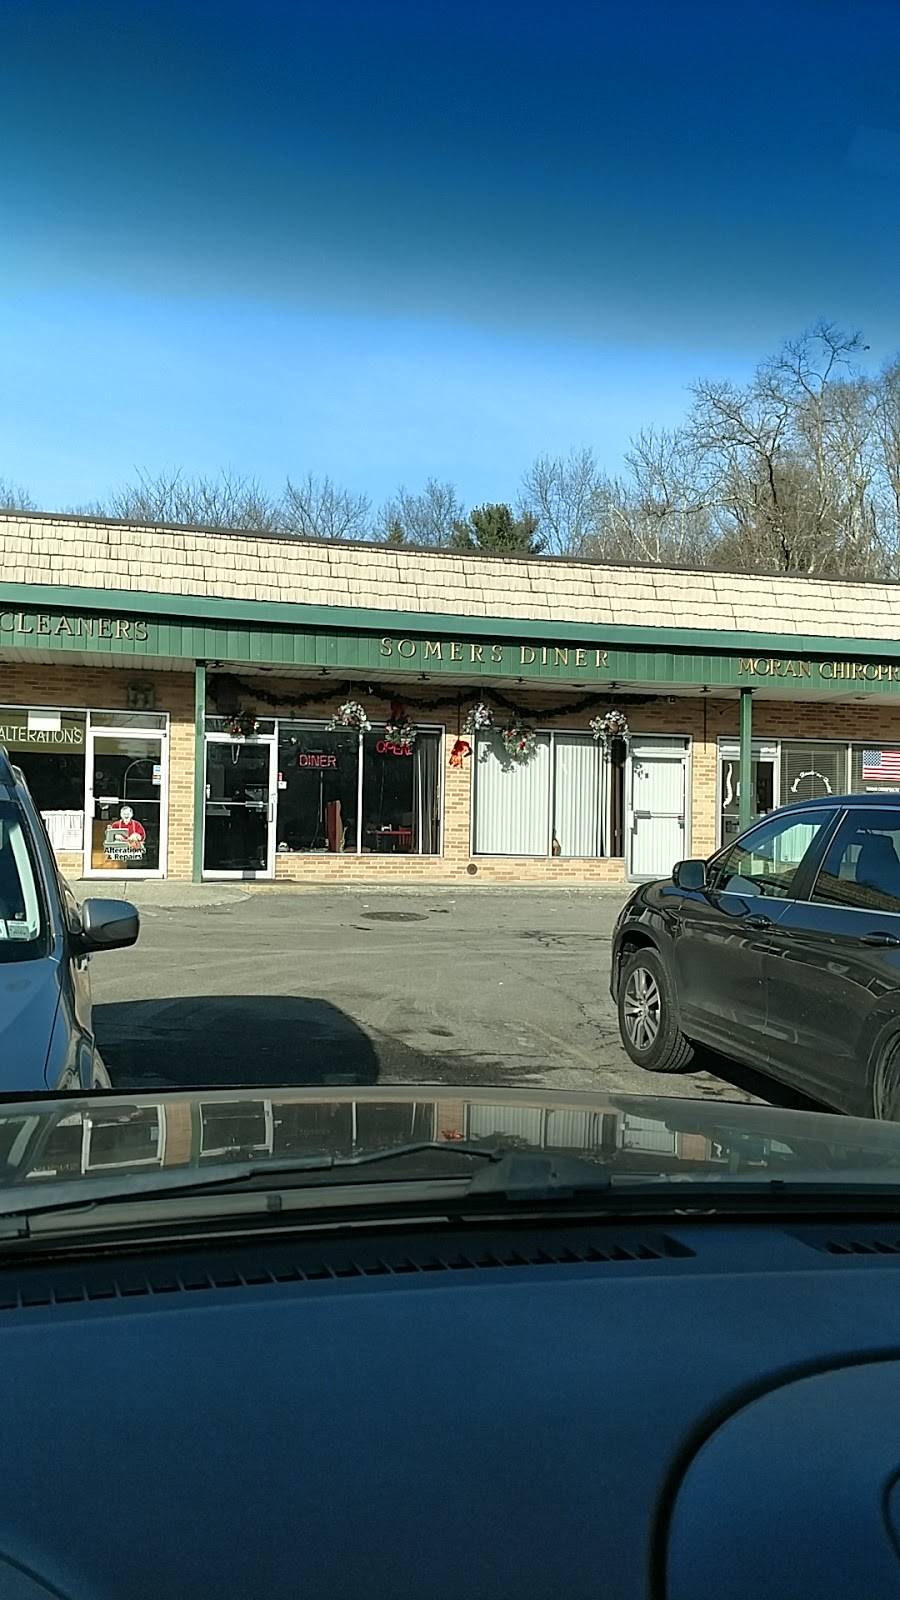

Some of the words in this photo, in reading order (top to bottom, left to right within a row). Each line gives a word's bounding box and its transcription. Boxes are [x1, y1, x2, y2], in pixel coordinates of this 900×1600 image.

[0, 611, 149, 641] CLEANERS
[380, 637, 504, 663] SOMERS
[519, 645, 610, 668] DINER
[737, 657, 812, 679] MORAN
[299, 754, 336, 767] DINER
